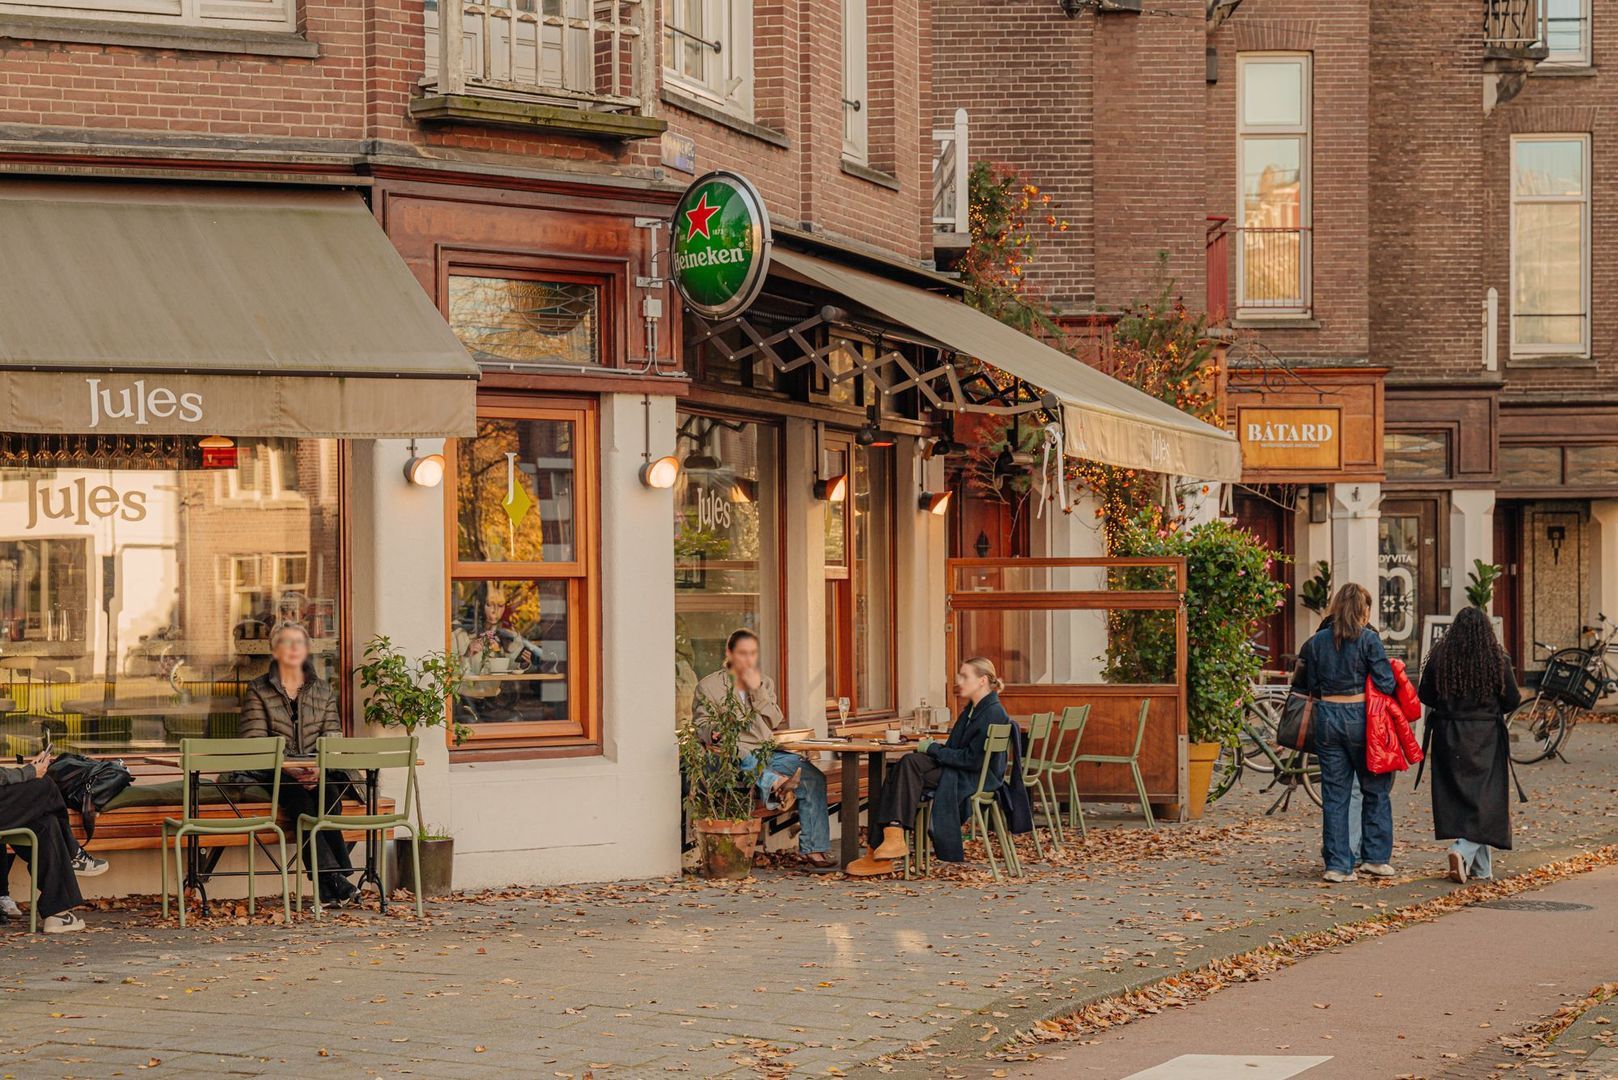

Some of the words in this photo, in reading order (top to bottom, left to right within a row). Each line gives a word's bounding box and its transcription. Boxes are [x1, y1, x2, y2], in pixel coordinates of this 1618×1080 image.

[675, 246, 745, 271] Heineken
[86, 378, 203, 426] Jules
[26, 476, 147, 529] Jules
[697, 487, 731, 532] Jules
